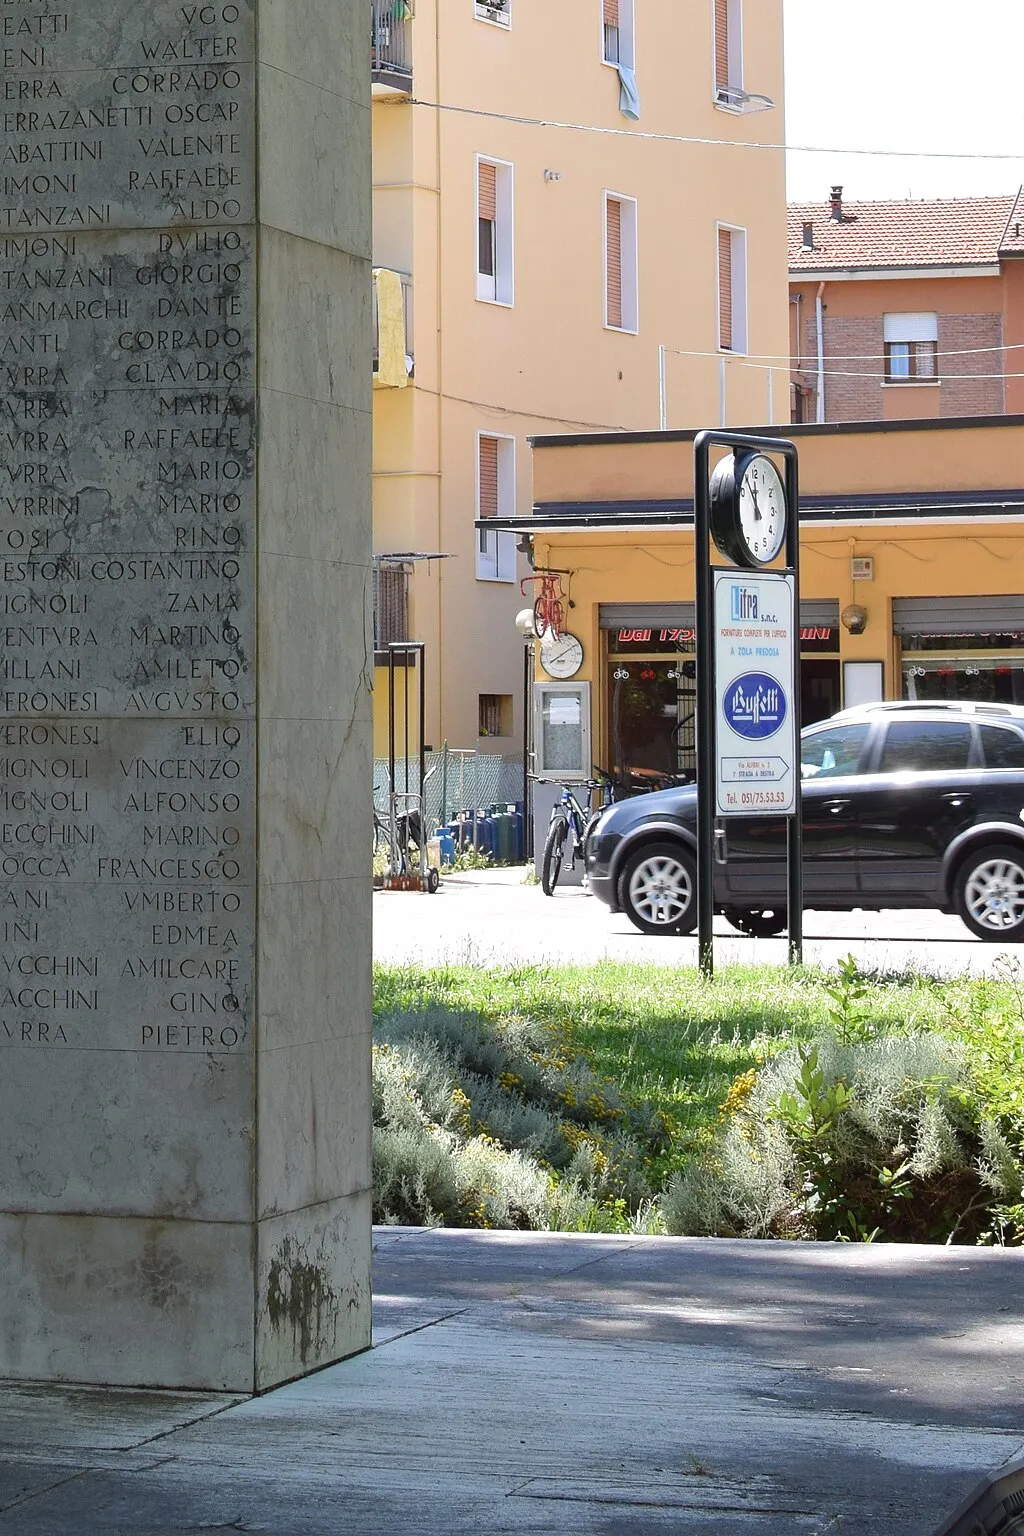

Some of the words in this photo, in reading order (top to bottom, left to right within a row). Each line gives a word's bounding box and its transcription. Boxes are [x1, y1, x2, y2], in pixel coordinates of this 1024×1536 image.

[141, 34, 238, 62] WALTER
[113, 68, 240, 96] CORRADO
[139, 132, 240, 158] VALENTE
[129, 165, 241, 192] RAFFAELE
[157, 294, 240, 318] DANTE
[157, 458, 240, 482] MARIO
[752, 469, 758, 479] 12
[768, 488, 773, 498] 2
[771, 507, 775, 517] 3
[768, 525, 773, 535] 4
[754, 542, 759, 552] 6
[762, 538, 767, 547] 5
[167, 591, 238, 614] ZAMA
[761, 614, 778, 622] s.n.c.
[731, 647, 735, 655] A
[738, 647, 752, 655] ZOLA
[756, 648, 779, 656] PREDOSA
[124, 690, 240, 712] AVGVSTO
[123, 792, 240, 813] ALFONSO
[727, 792, 737, 804] Tel.
[742, 792, 785, 804] 051/75.53.53
[142, 824, 240, 846] MARINO
[151, 923, 238, 947] EDMEA
[120, 957, 239, 981] AMILCARE
